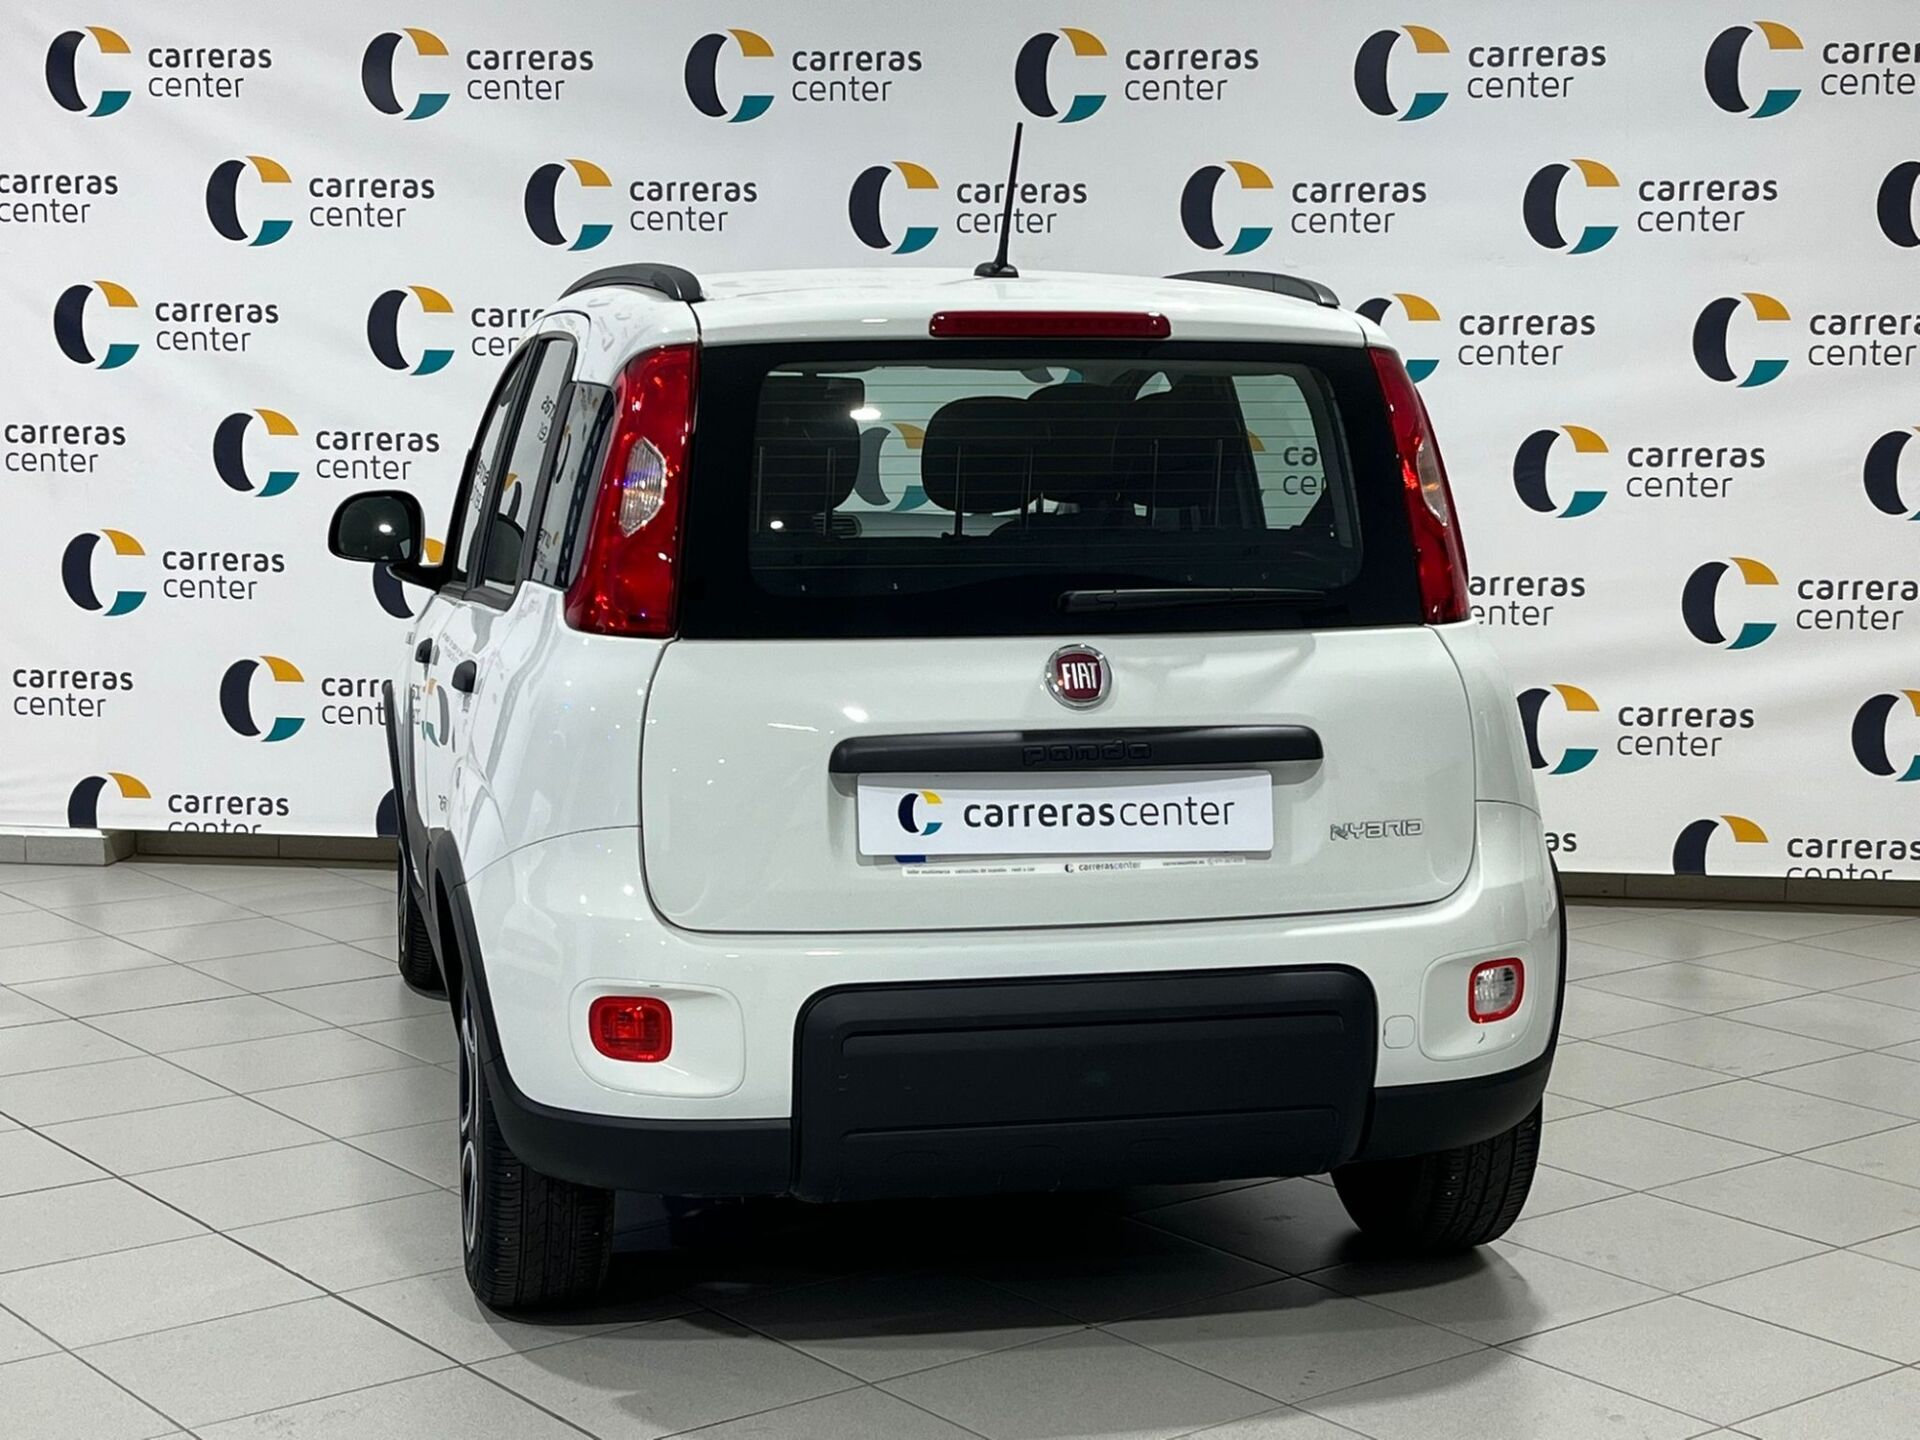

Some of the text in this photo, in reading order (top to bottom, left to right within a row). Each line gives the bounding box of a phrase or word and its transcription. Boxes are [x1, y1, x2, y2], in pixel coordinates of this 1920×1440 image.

[149, 48, 271, 68] carreras
[467, 50, 593, 70] carreras
[793, 51, 922, 71] carreras
[1126, 49, 1258, 70] carreras
[1469, 46, 1606, 67] carreras
[149, 73, 244, 97] center
[468, 75, 565, 100] center
[793, 76, 892, 101] center
[1125, 75, 1227, 100] center
[1468, 72, 1574, 98] center
[0, 174, 118, 195] carreras
[309, 178, 434, 199] carreras
[630, 181, 757, 202] carreras
[957, 183, 1087, 203] careras
[1292, 182, 1426, 203] carreras
[1639, 180, 1777, 201] carreras
[0, 199, 90, 223] center
[310, 203, 406, 227] center
[631, 206, 728, 231] center
[1292, 208, 1395, 233] center
[1638, 206, 1745, 232] center
[156, 303, 278, 323] carreras
[1460, 315, 1595, 335] carreras
[157, 327, 251, 351] center
[1459, 340, 1563, 365] center
[1809, 340, 1917, 365] center
[5, 425, 125, 445] carreras
[316, 431, 439, 452] carreras
[6, 449, 98, 472] center
[317, 456, 411, 480] center
[1628, 448, 1765, 468] carreras
[1627, 472, 1733, 497] center
[163, 551, 284, 572] carreras
[164, 576, 257, 599] center
[1797, 605, 1904, 630] center
[13, 669, 133, 690] carreras
[1061, 662, 1098, 690] FIAT
[14, 694, 106, 717] center
[1619, 707, 1754, 728] carreras
[1023, 738, 1152, 766] panda
[1617, 732, 1722, 756] center
[168, 794, 289, 816] carreras
